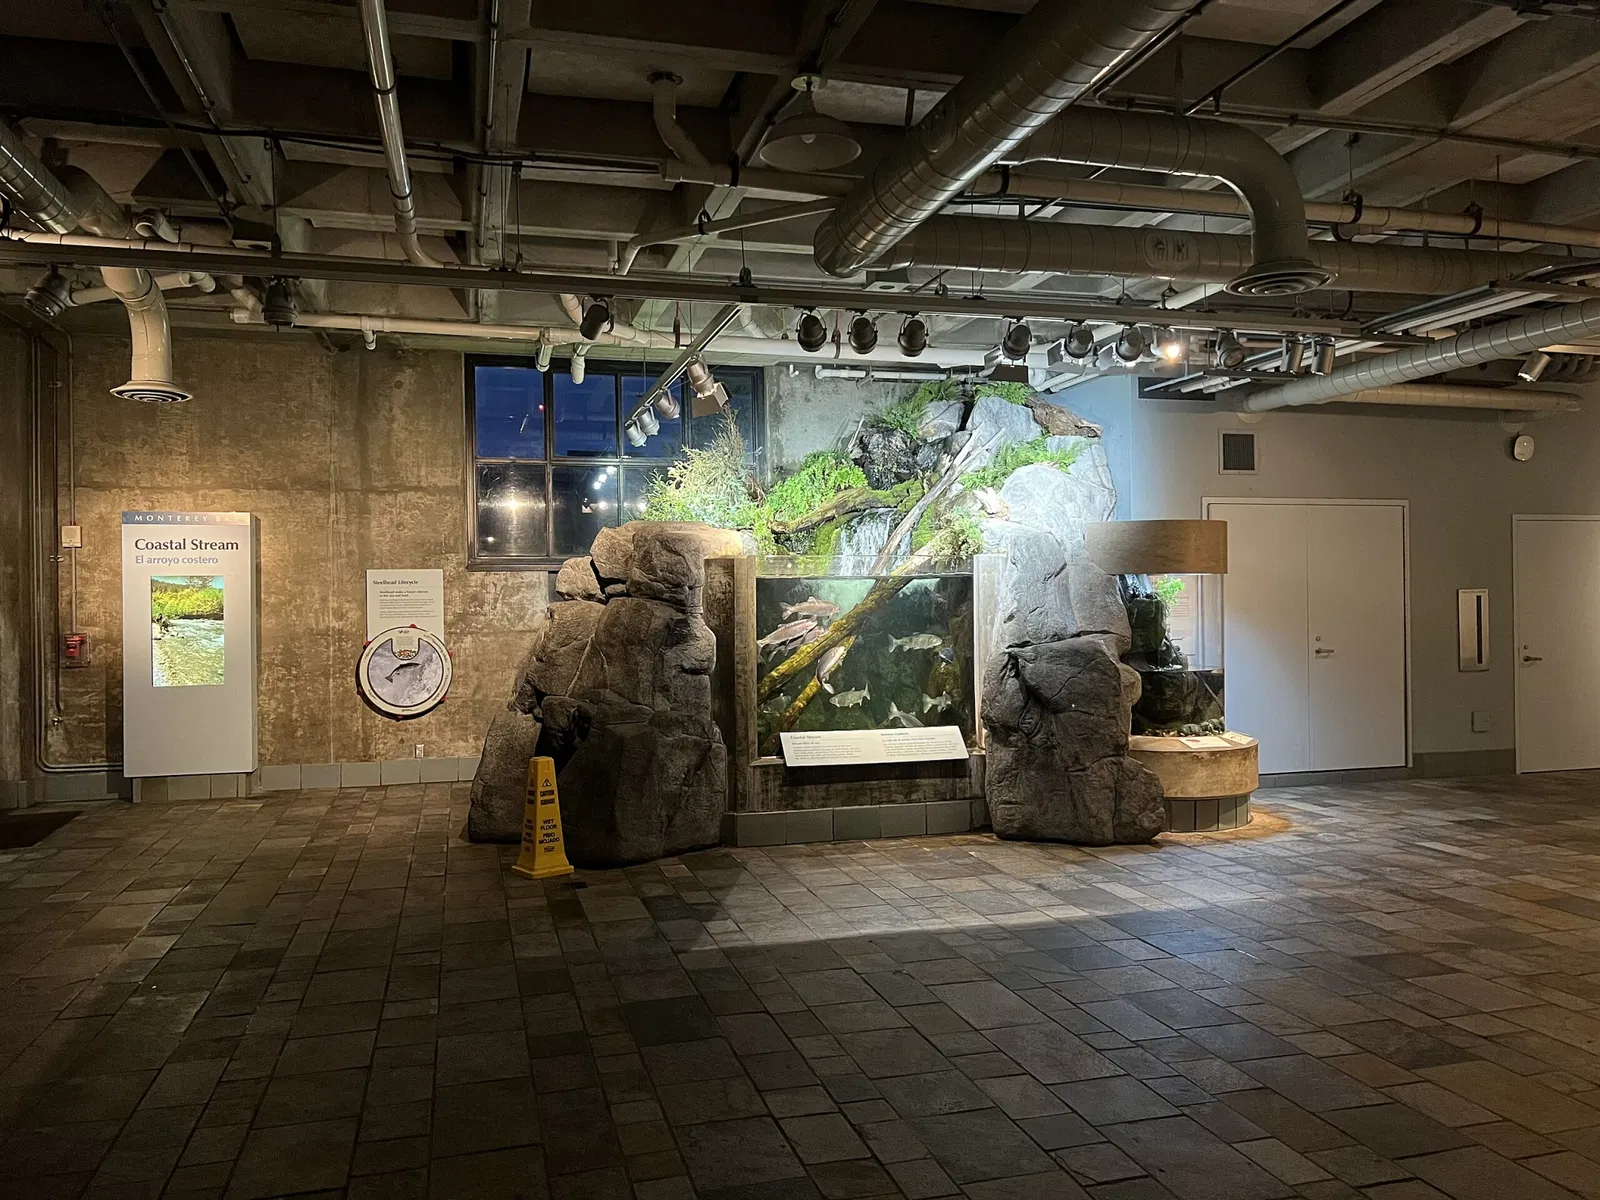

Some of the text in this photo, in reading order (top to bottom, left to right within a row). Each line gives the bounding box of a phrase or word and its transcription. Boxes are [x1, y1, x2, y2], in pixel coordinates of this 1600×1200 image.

[134, 514, 239, 522] MONTEREY BAY
[134, 538, 239, 551] Coastal Stream
[135, 555, 219, 566] El arroyo costero
